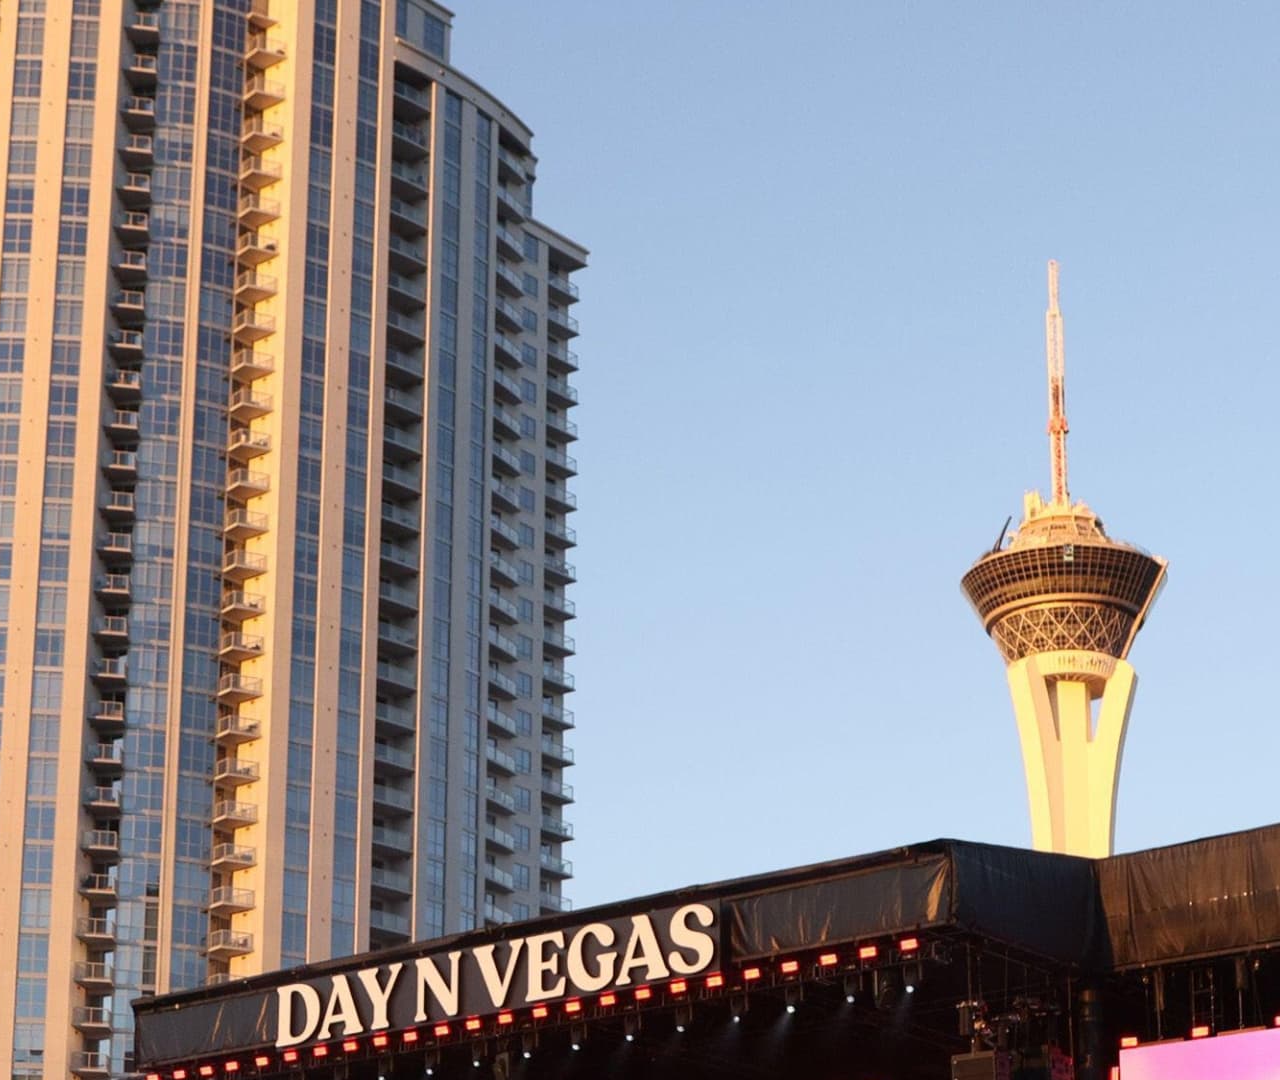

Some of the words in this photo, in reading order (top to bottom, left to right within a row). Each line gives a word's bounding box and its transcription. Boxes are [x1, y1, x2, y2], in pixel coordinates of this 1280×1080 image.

[276, 963, 403, 1048] DAY
[414, 951, 461, 1022] N
[473, 903, 715, 1008] VEGAS
